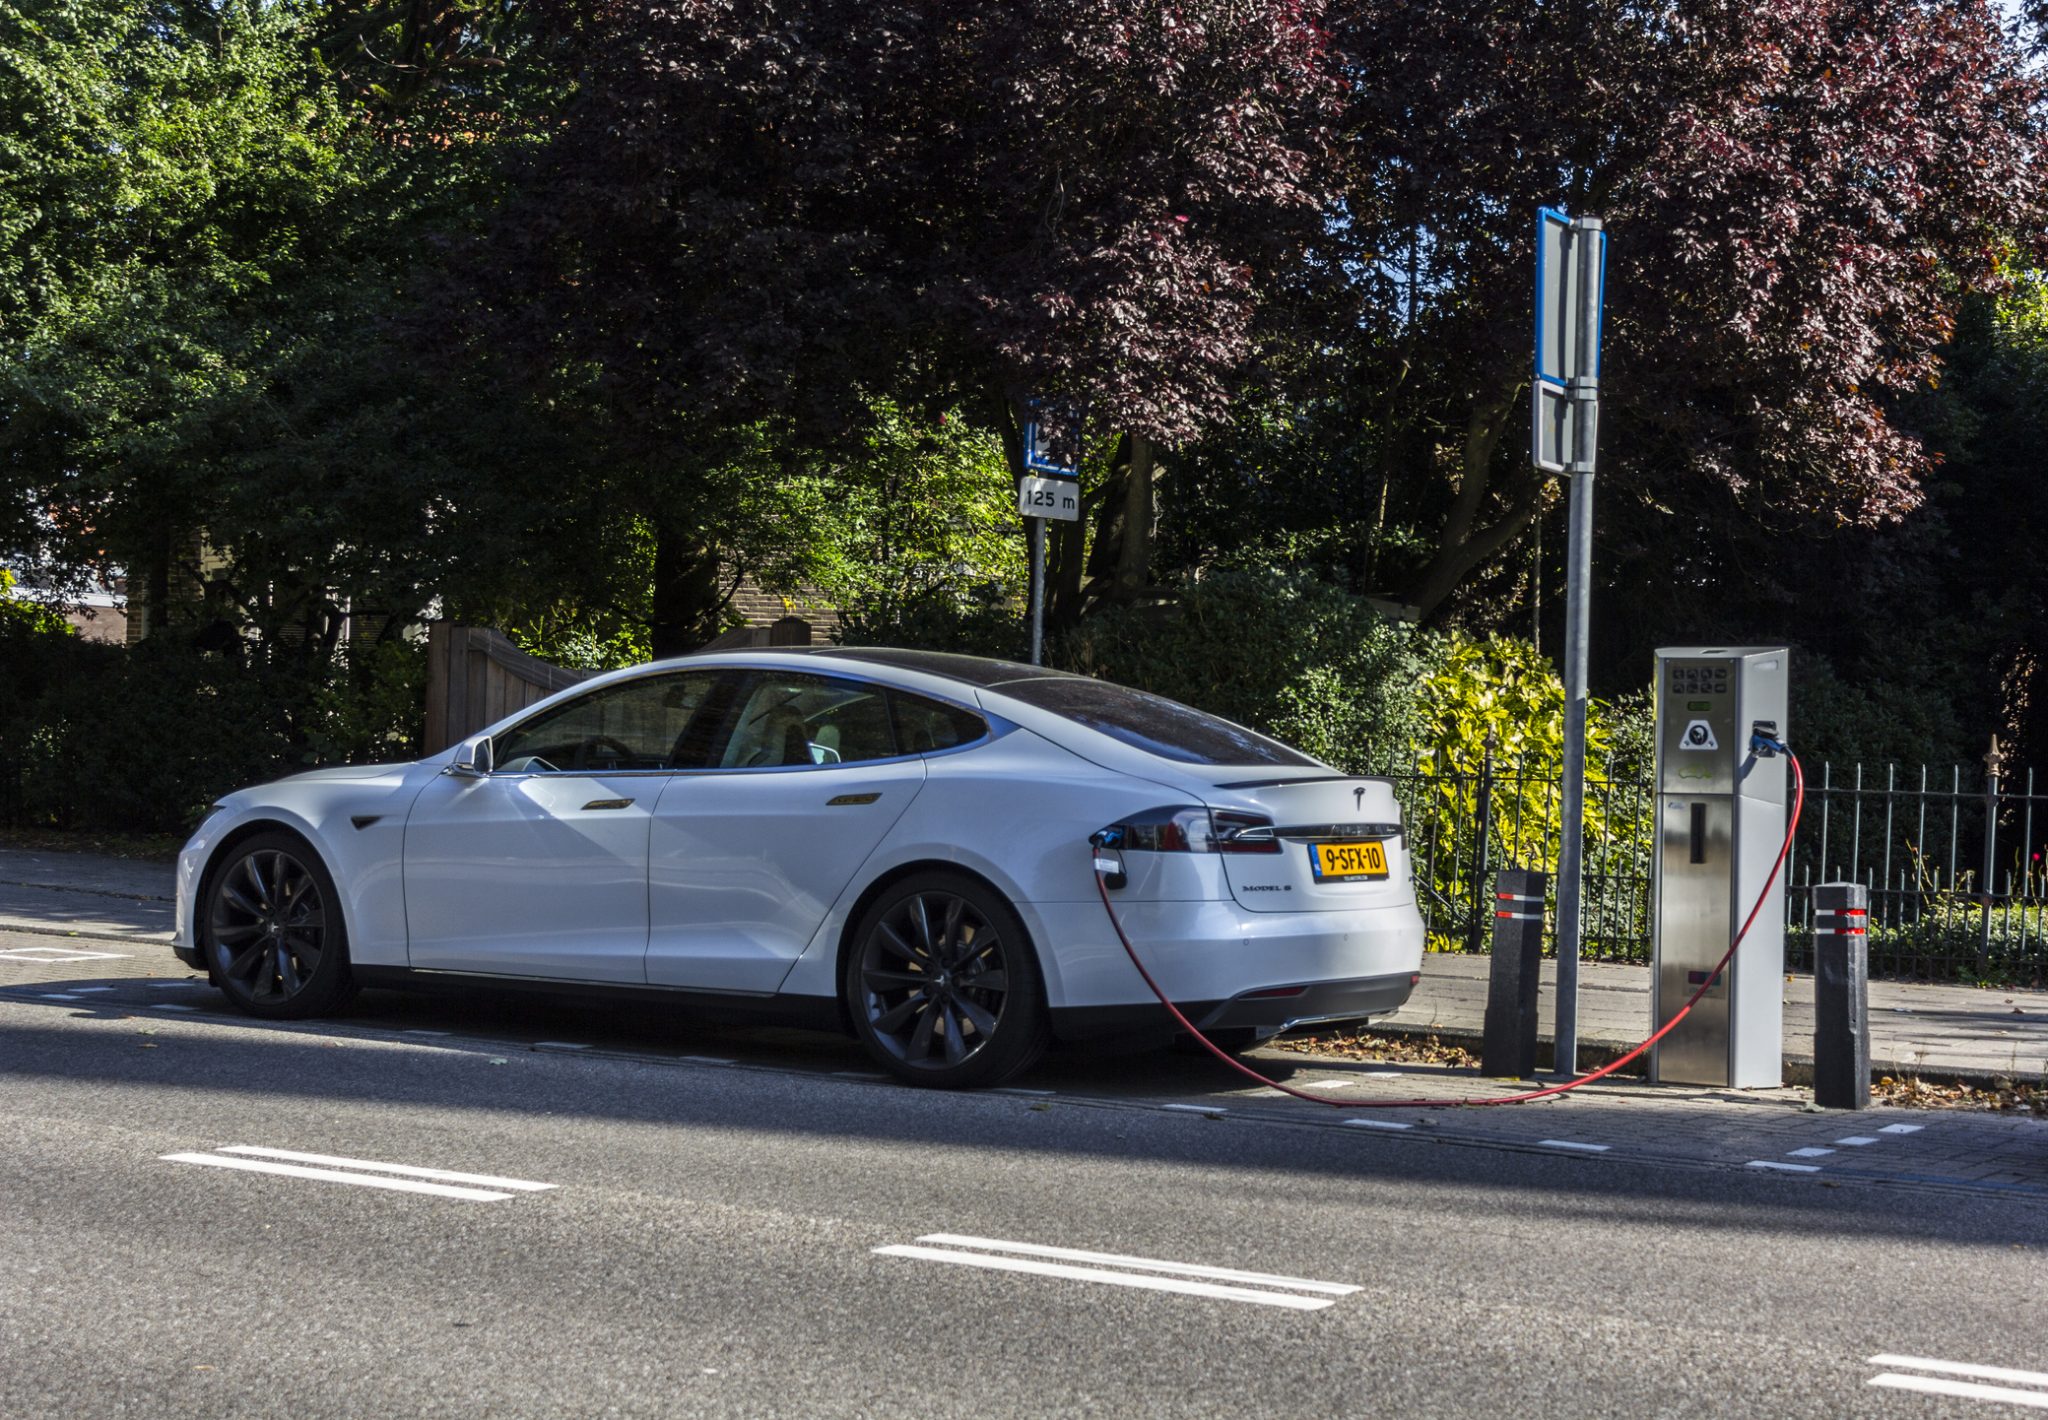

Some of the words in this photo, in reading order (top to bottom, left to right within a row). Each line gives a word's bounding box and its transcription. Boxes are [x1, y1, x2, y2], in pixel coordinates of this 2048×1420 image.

[1027, 490, 1055, 507] 125
[1063, 497, 1075, 509] m
[1326, 847, 1380, 871] 9-SFX-10
[1242, 884, 1282, 892] MODEL
